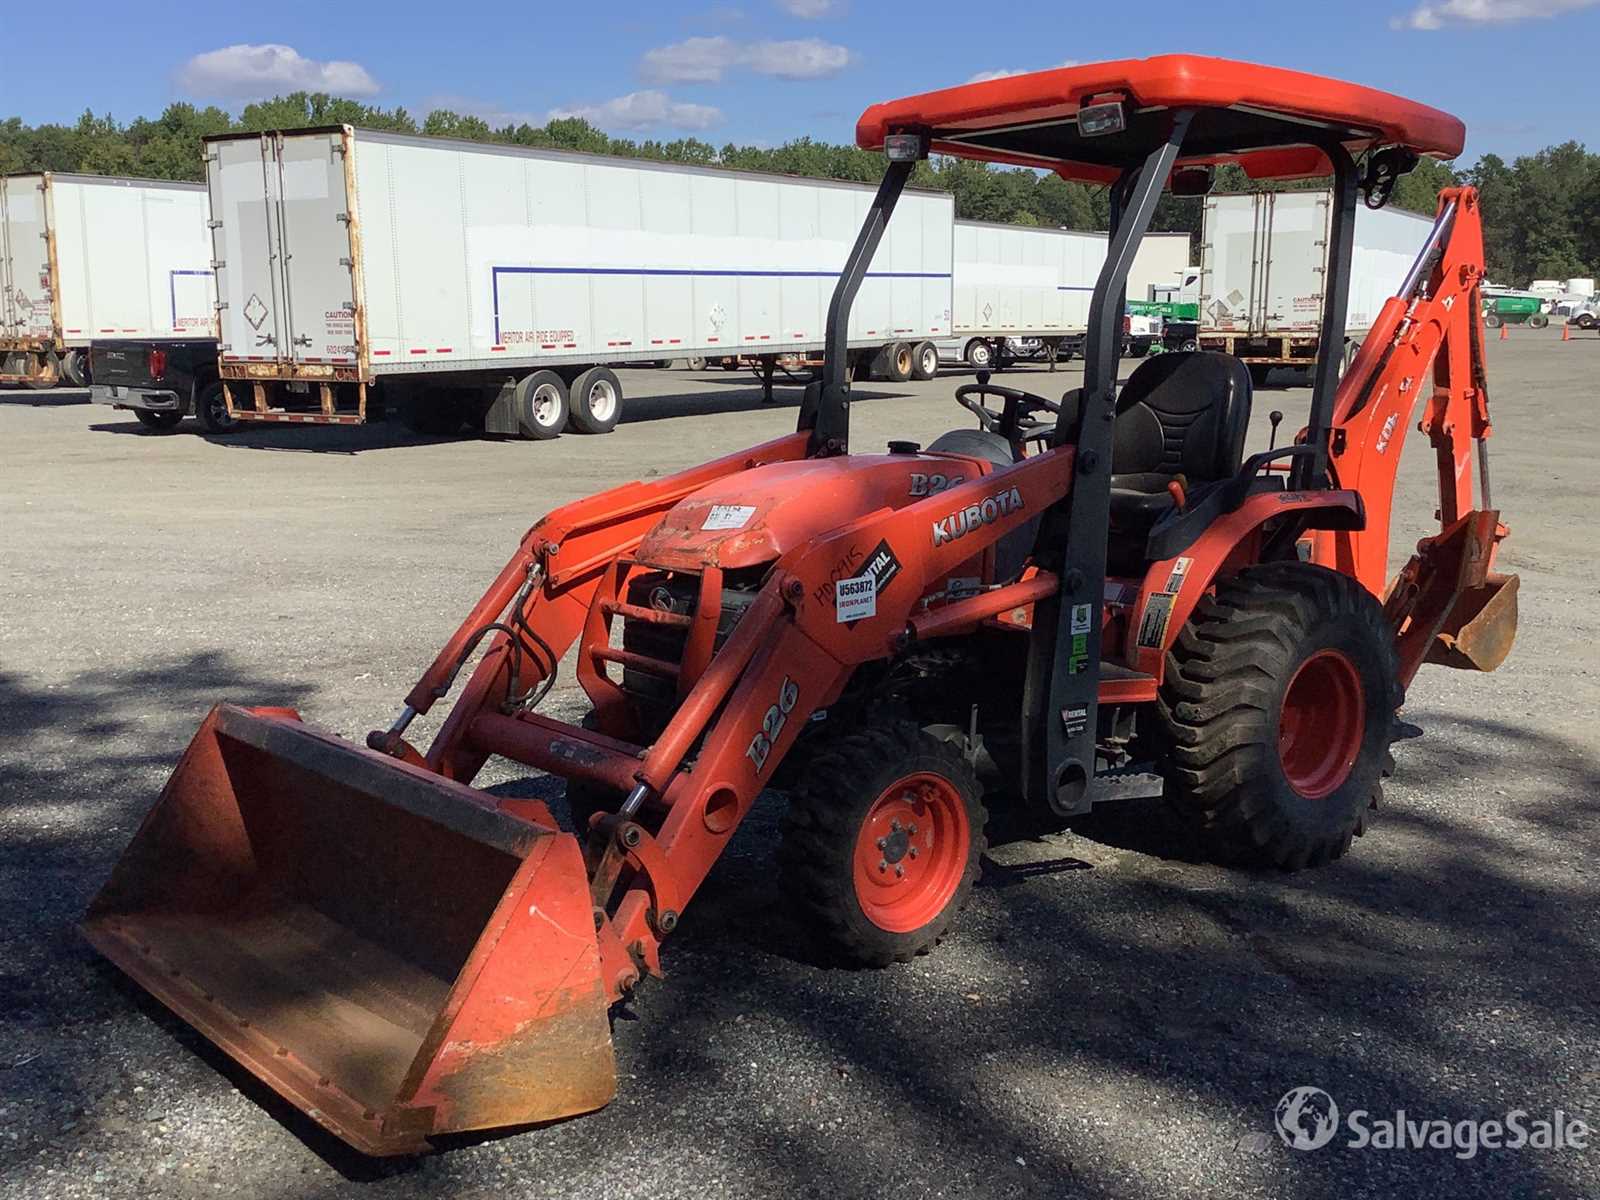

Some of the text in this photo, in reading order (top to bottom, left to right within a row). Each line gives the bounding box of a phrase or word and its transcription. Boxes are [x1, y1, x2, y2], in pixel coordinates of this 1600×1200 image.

[325, 311, 353, 319] CAUTION
[932, 485, 1024, 547] KUBOTA
[839, 580, 873, 597] U563872
[745, 674, 799, 774] B26
